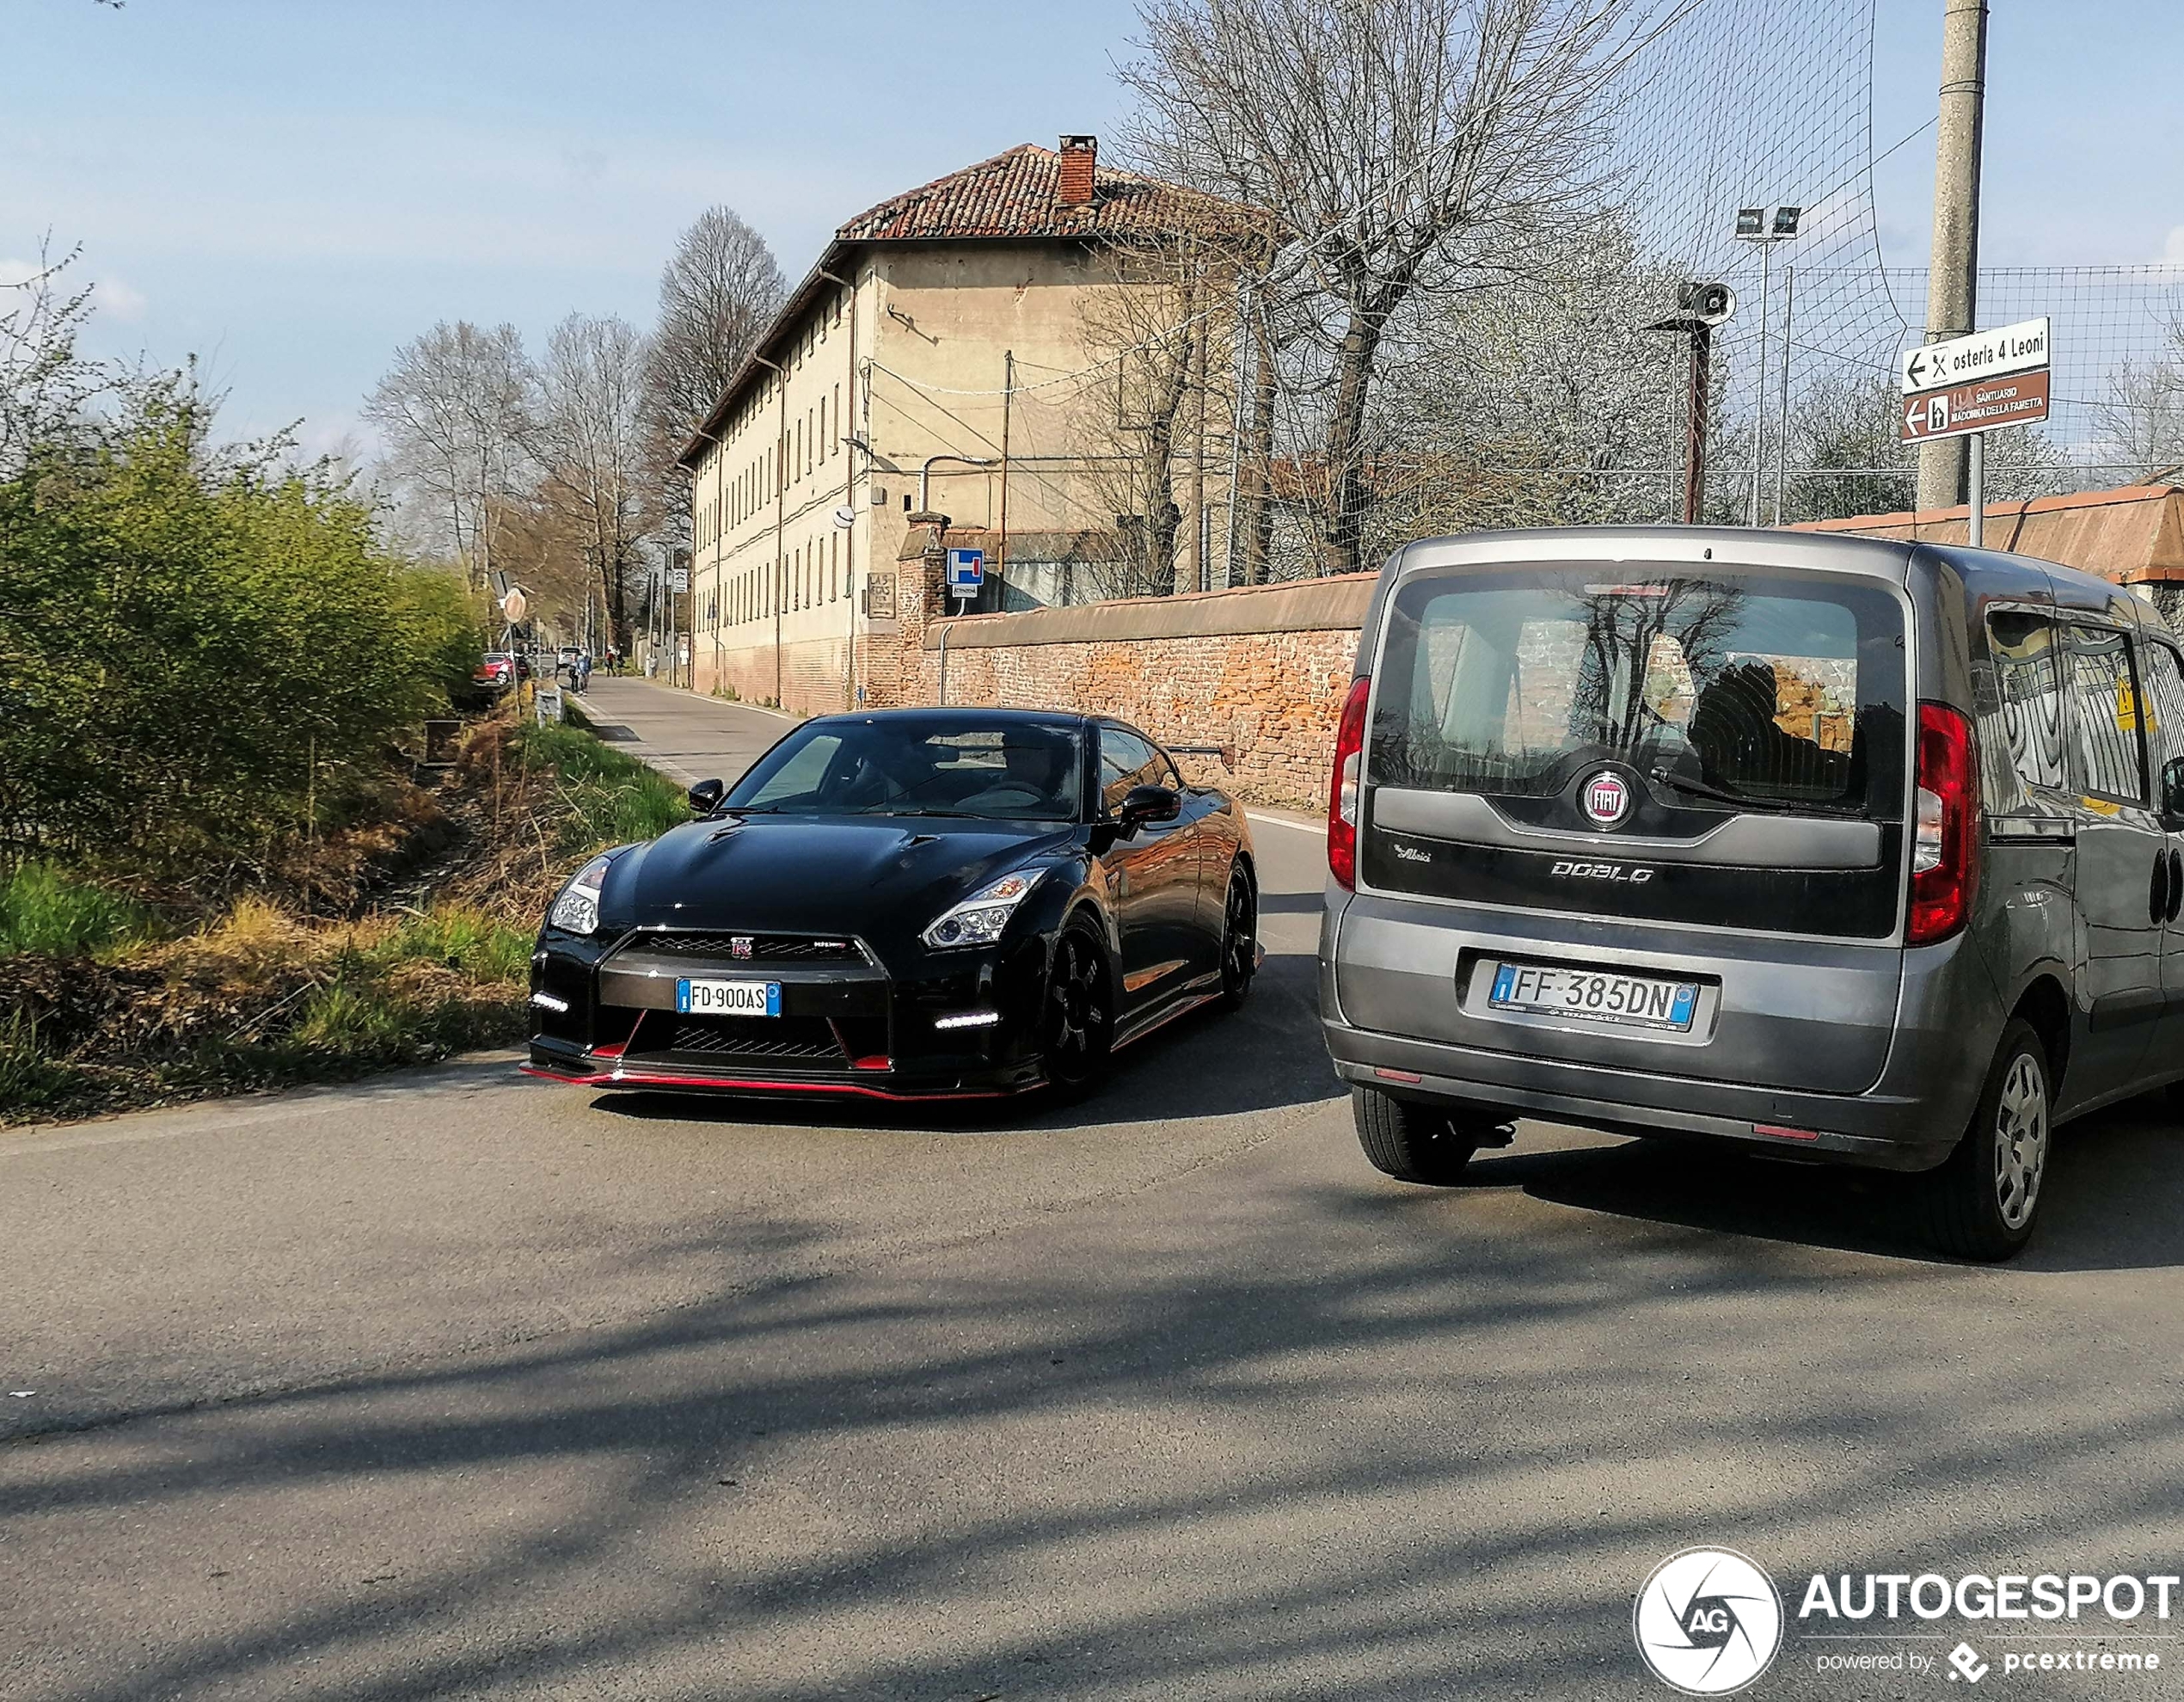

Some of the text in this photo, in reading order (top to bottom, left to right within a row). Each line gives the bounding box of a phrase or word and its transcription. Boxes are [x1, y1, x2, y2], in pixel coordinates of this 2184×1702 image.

[1954, 330, 2043, 370] osteria 4 Leoni
[1976, 386, 2017, 404] SANTUARIO
[1950, 407, 1986, 423] MADONNA
[1986, 402, 2009, 417] DELLA
[1593, 789, 1620, 811] FIAT
